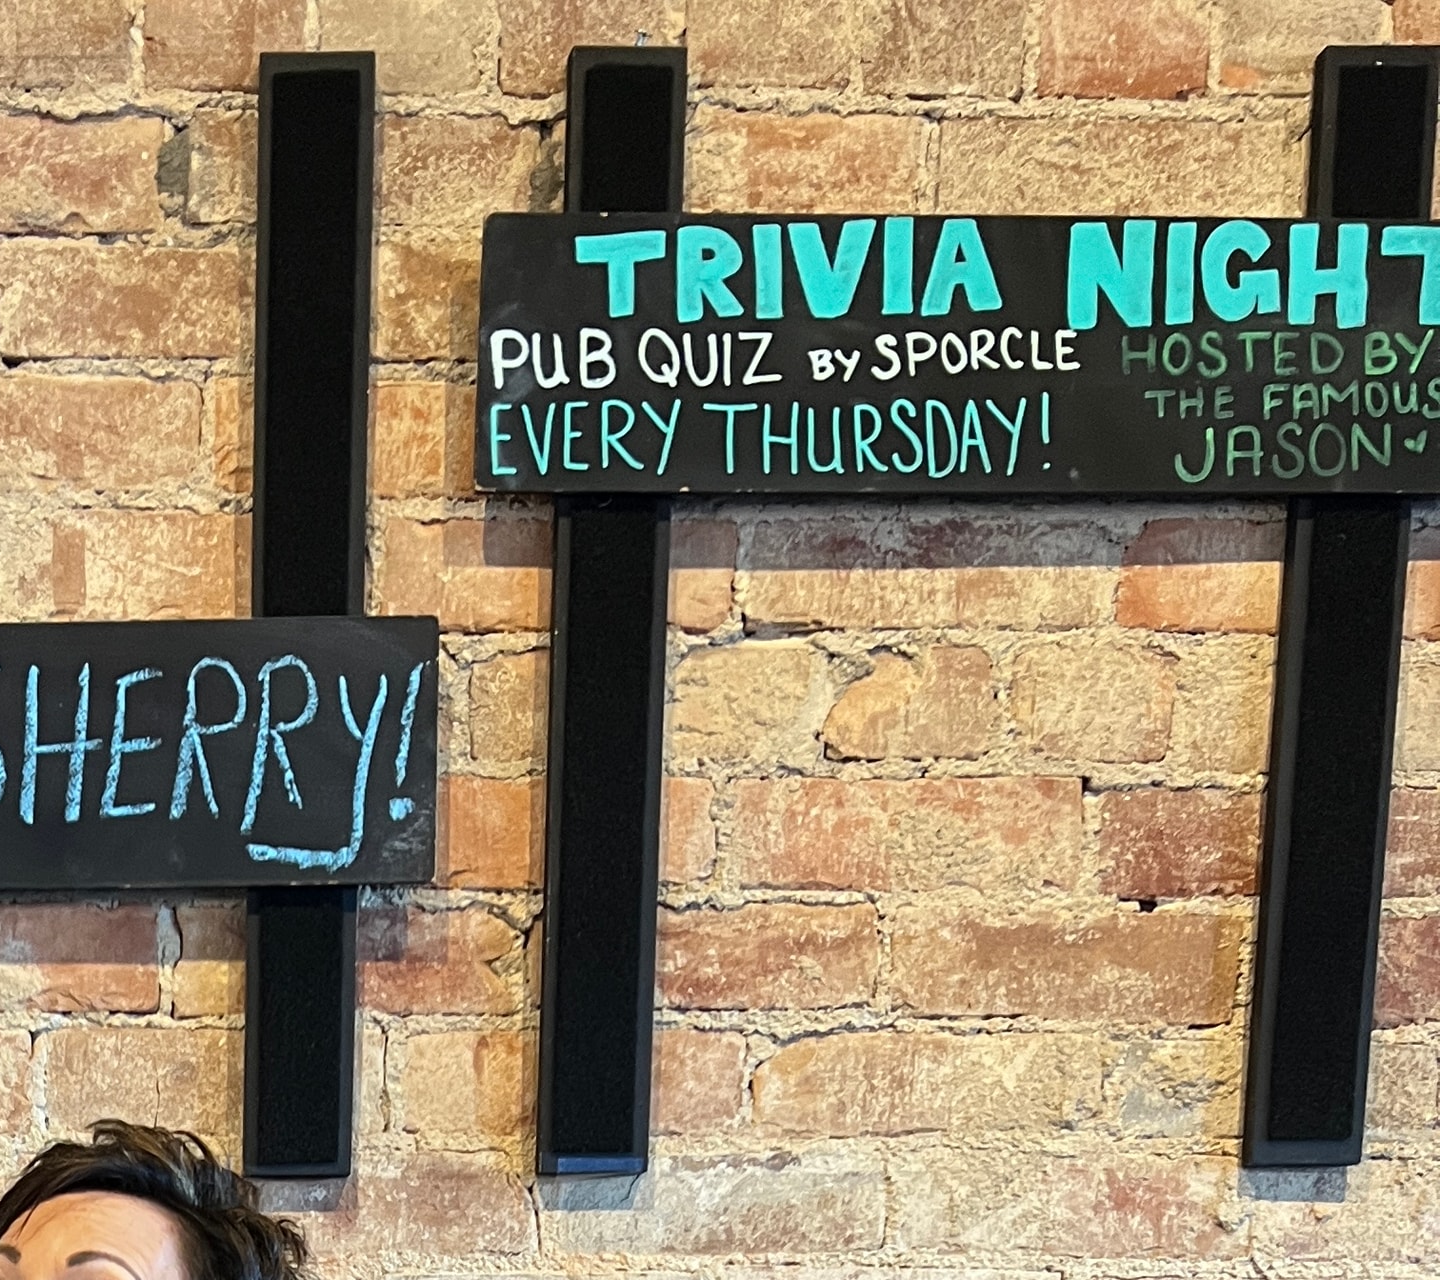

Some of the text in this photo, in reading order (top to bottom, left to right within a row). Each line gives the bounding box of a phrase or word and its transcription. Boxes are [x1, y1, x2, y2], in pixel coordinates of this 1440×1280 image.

[575, 216, 1440, 330] TRIVIA NIGHT
[490, 326, 1081, 390] PUB QUIZ BY SPORCLE
[1122, 329, 1435, 377] HOSTED BY
[1144, 377, 1440, 419] THE FAMOUS
[490, 391, 1053, 479] EVERY THURSDAY!
[1174, 422, 1392, 483] JASON
